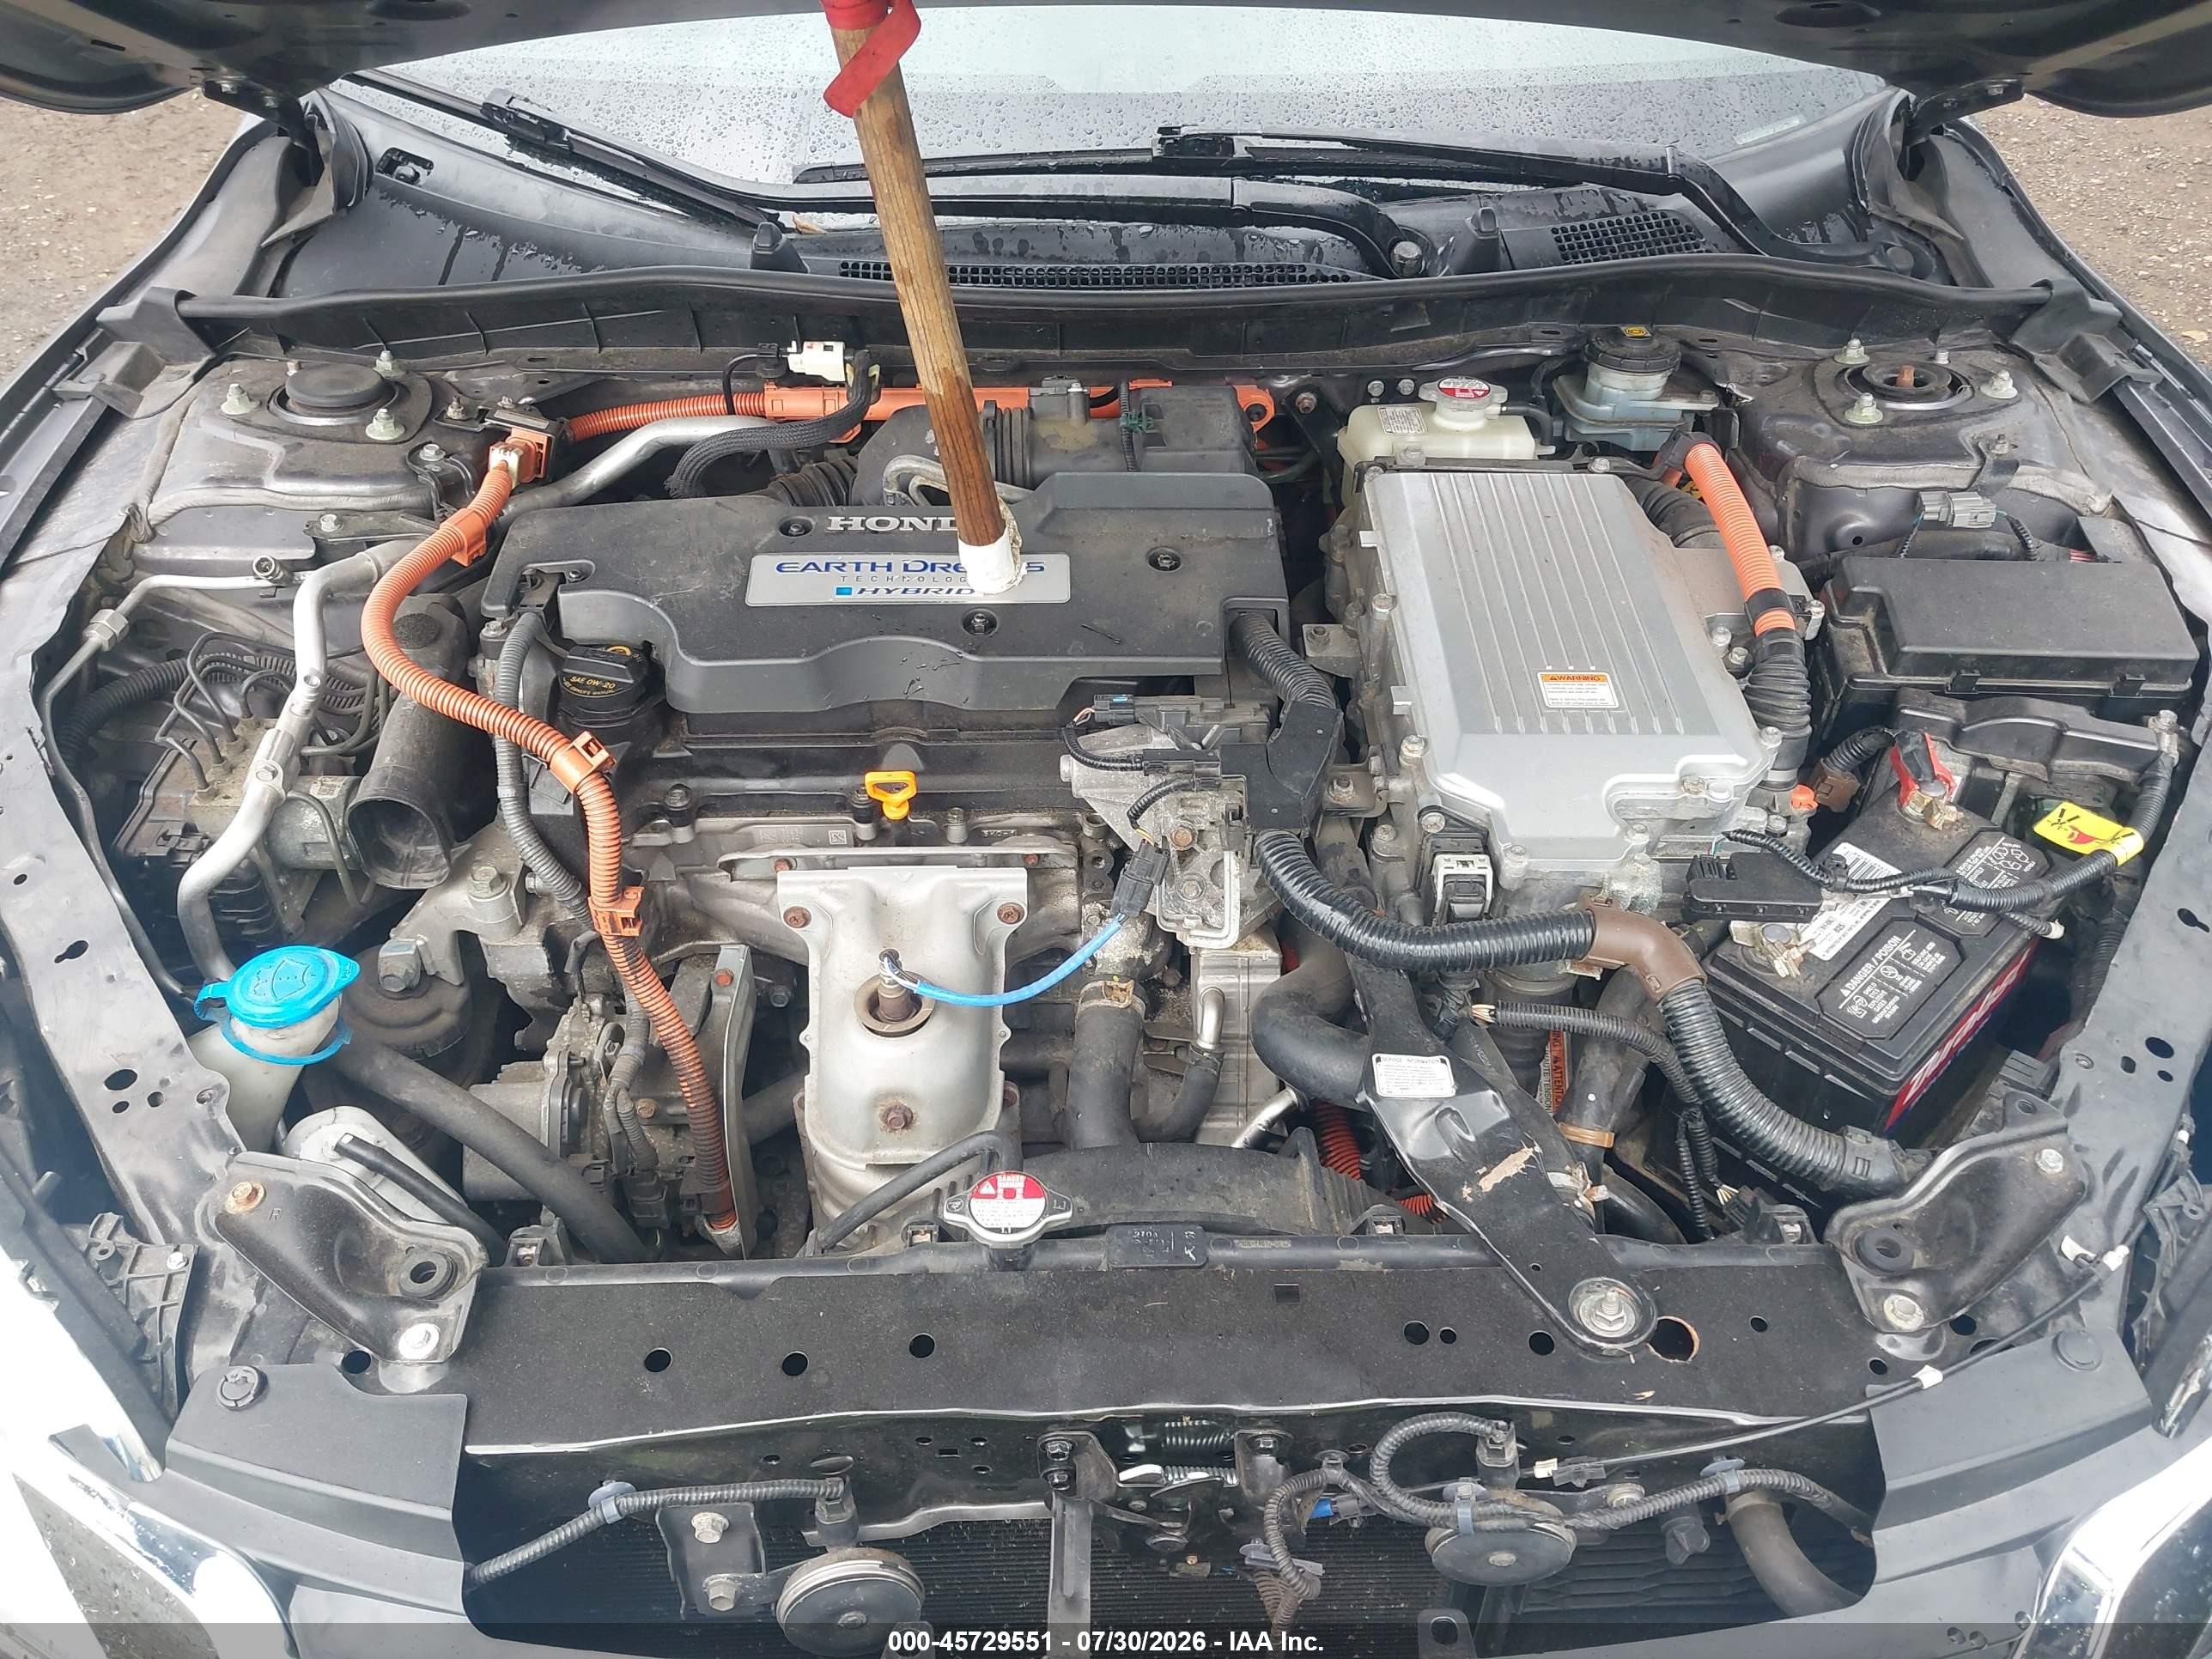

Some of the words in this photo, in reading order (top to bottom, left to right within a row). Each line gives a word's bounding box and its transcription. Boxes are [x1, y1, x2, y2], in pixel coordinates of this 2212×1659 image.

[776, 561, 893, 573] EARTH
[902, 560, 1045, 573] DRES
[569, 676, 586, 684] SAE
[586, 678, 616, 690] 0W-20
[1844, 962, 1876, 991] DANGER
[1874, 934, 1903, 961] POISON
[1543, 1079, 1553, 1111] TENSION
